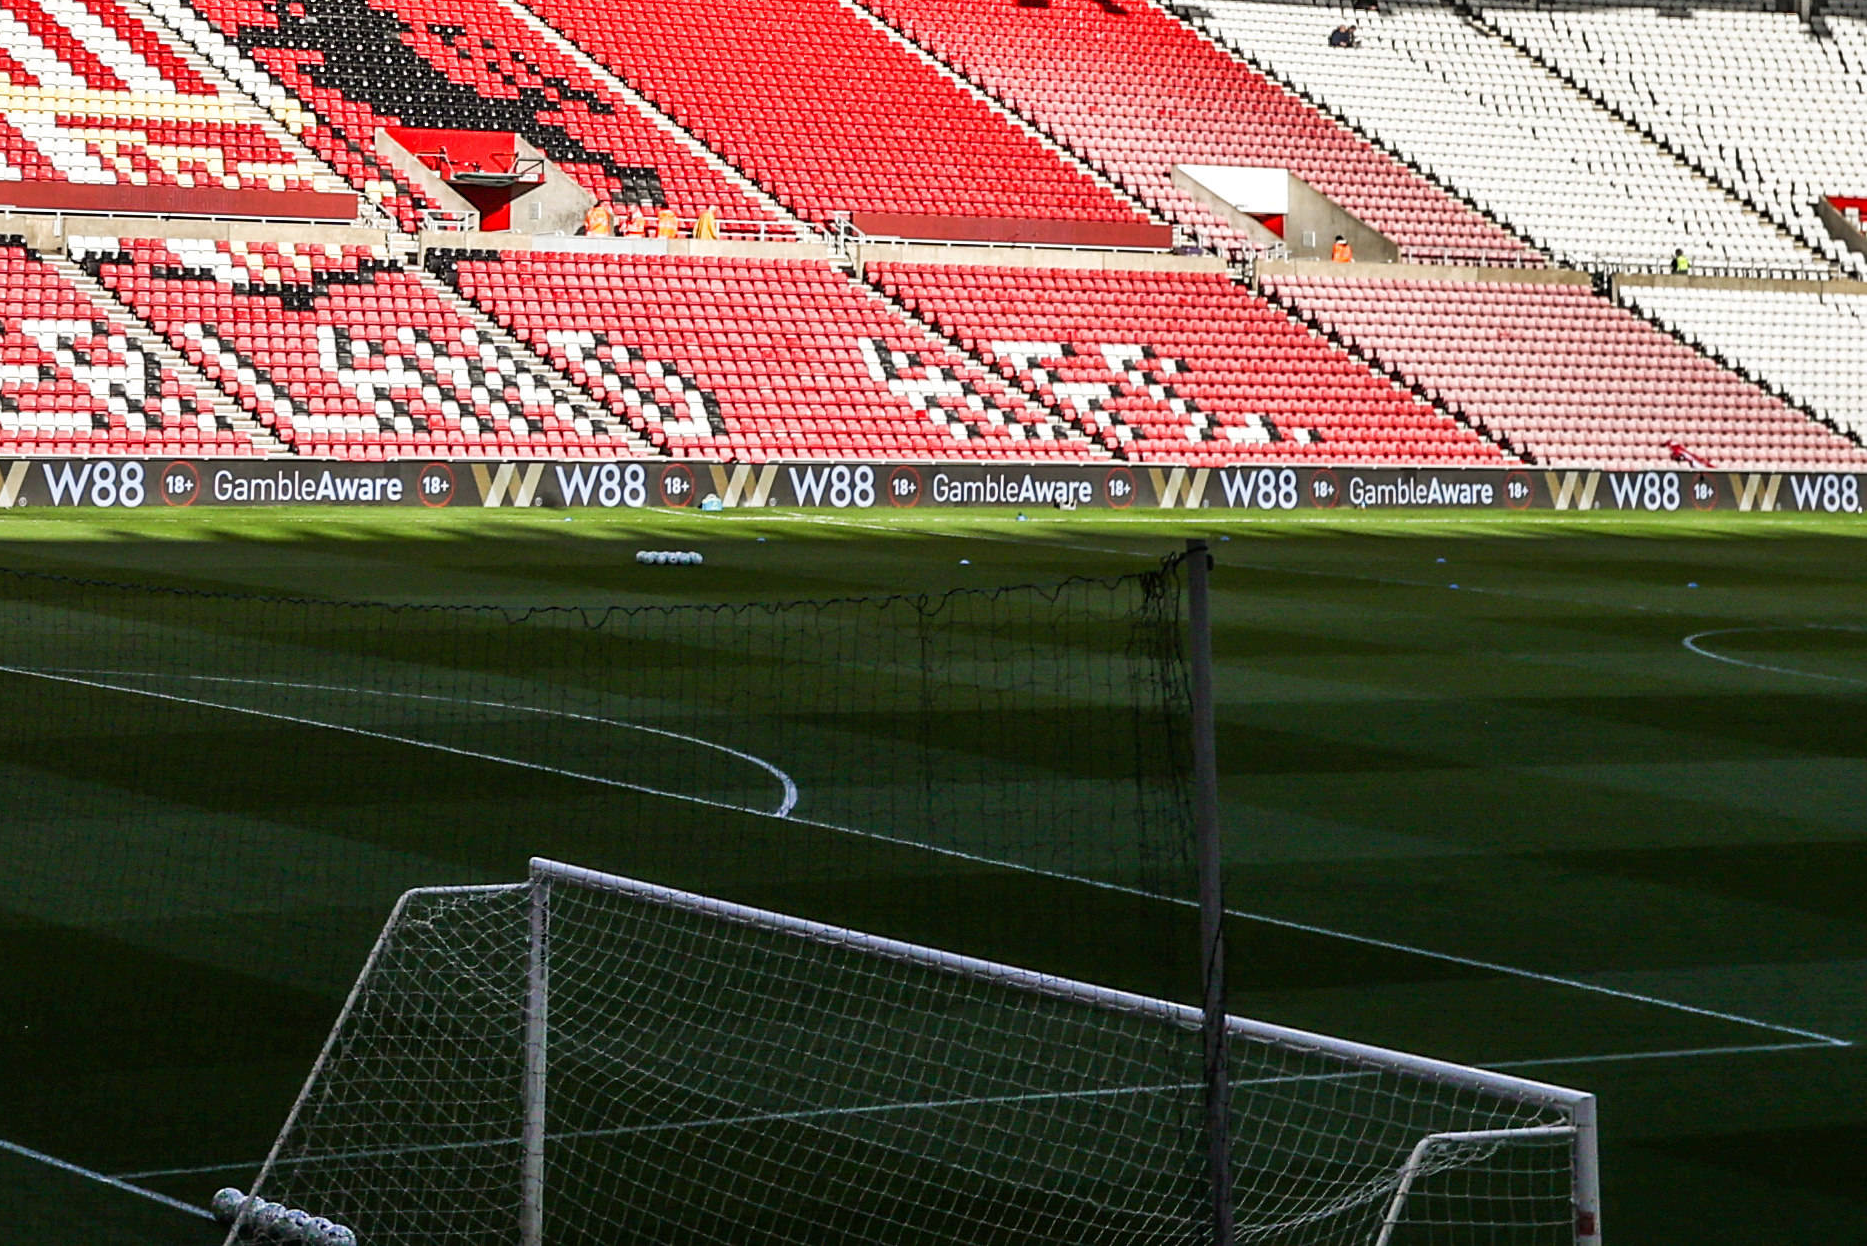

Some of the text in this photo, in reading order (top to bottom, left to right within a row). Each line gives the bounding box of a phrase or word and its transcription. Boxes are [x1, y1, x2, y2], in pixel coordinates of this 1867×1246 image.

[43, 461, 145, 507] W88
[166, 475, 194, 494] 18+
[214, 470, 403, 502] GambleAware
[422, 475, 449, 494] 18+
[556, 463, 646, 507] W88
[664, 476, 690, 495] 18+
[789, 465, 875, 507] W88
[893, 478, 917, 495] 18+
[933, 473, 1092, 503] GambleAware
[1108, 477, 1130, 496] 18+
[1220, 469, 1297, 509] W88
[1312, 480, 1335, 497] 18+
[1349, 477, 1493, 506] GambleAware
[1507, 482, 1528, 498] 18+
[1610, 473, 1680, 511] W88
[1694, 484, 1714, 500] 18+
[1791, 475, 1857, 513] W88
